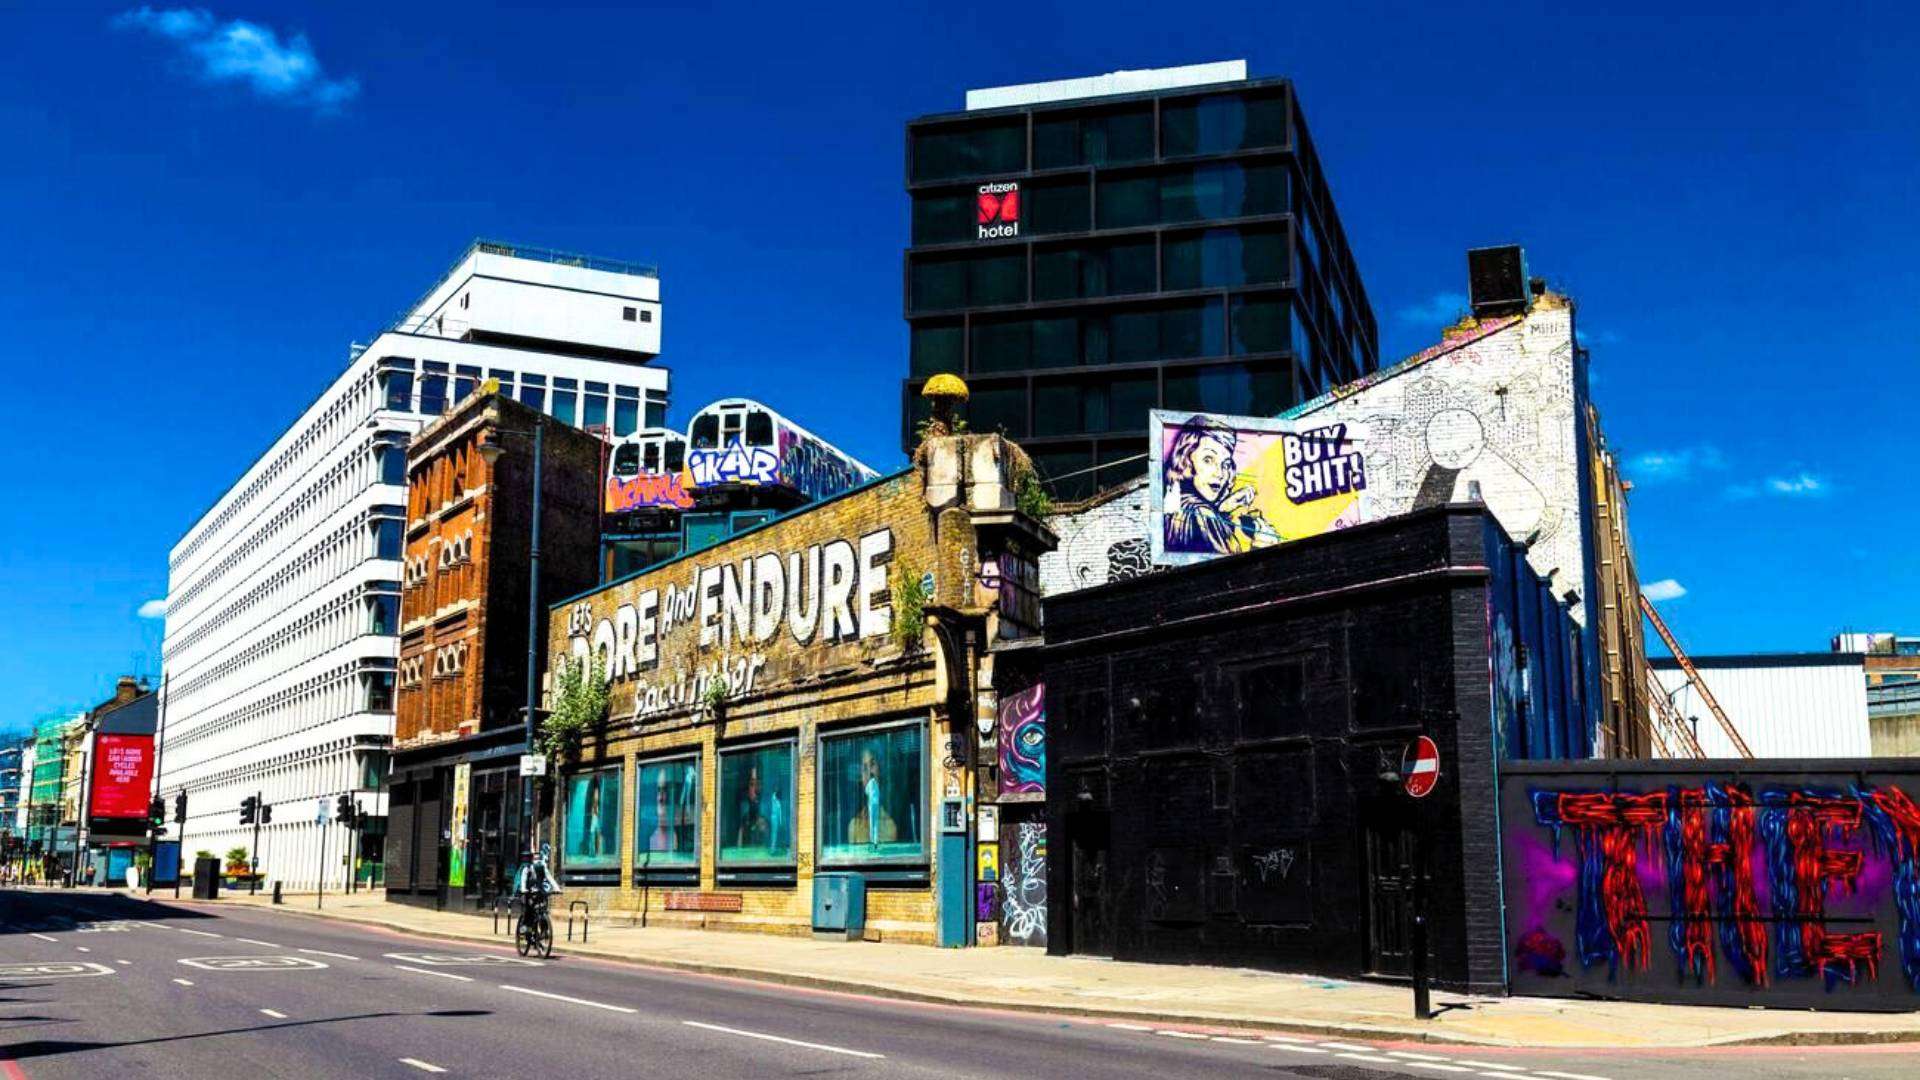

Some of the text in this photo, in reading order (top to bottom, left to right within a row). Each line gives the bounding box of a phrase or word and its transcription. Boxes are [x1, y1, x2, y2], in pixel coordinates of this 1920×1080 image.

[979, 182, 1018, 194] citizen
[978, 221, 1018, 238] hotel
[1283, 423, 1346, 466] BUY
[1285, 453, 1365, 502] SHIT!
[700, 527, 895, 649] ENDURE
